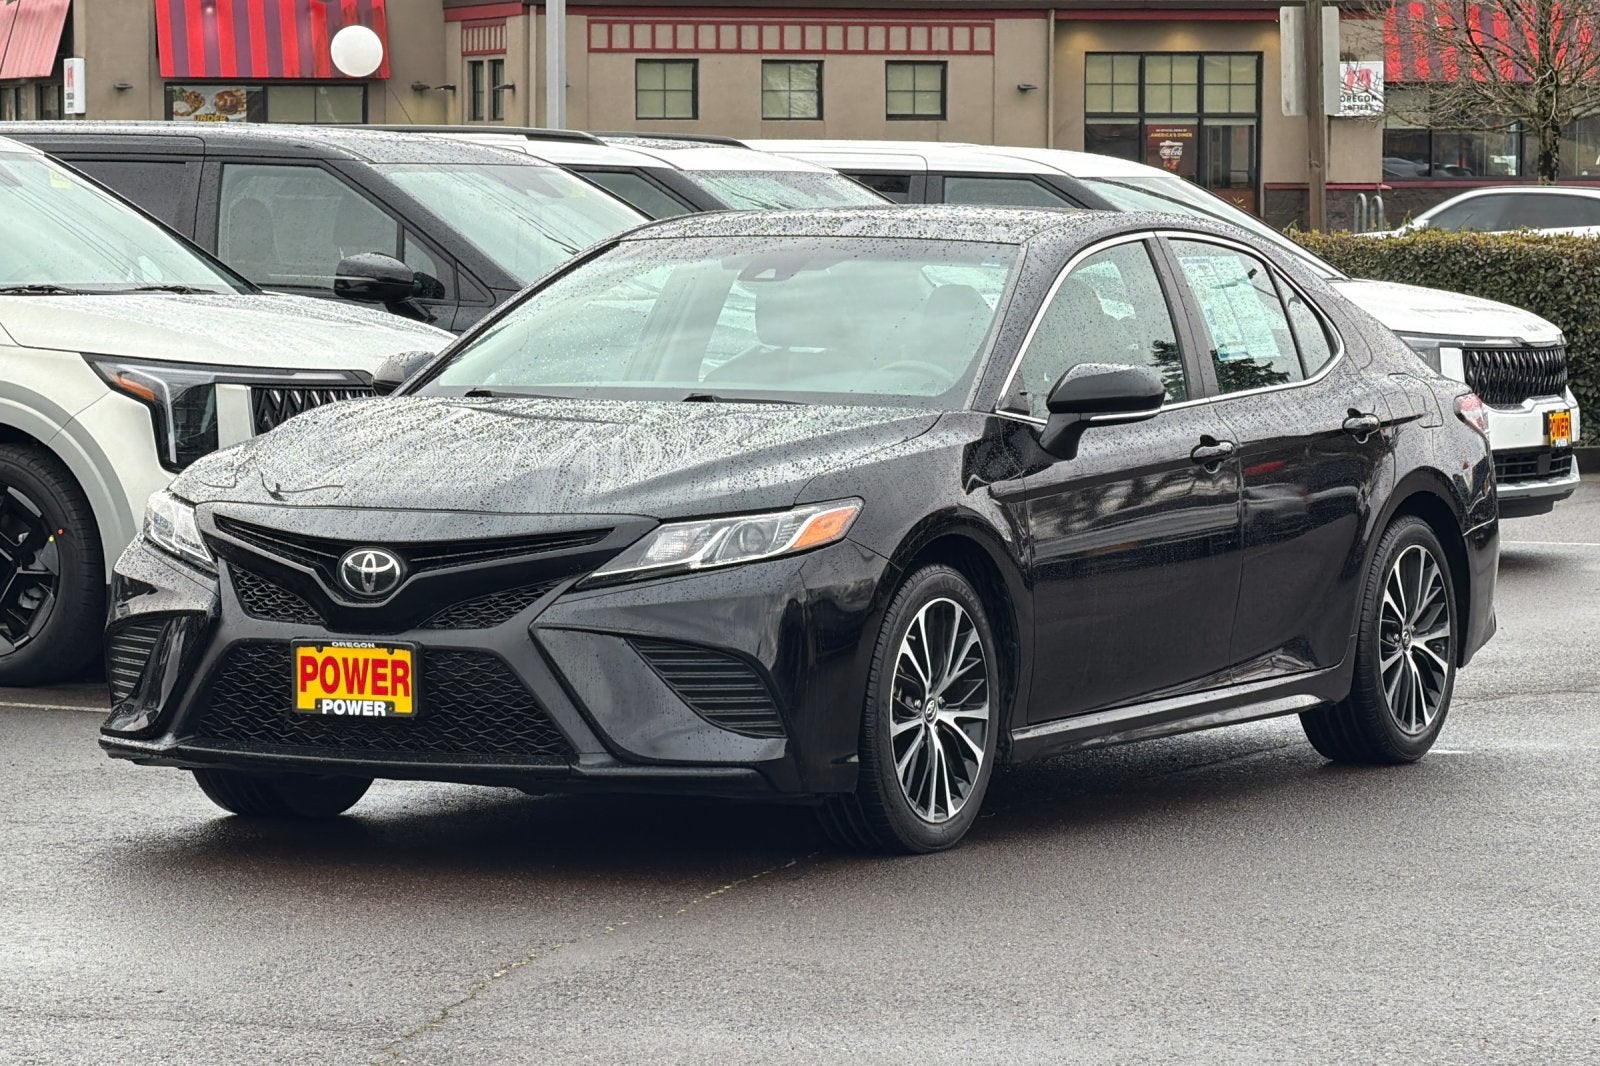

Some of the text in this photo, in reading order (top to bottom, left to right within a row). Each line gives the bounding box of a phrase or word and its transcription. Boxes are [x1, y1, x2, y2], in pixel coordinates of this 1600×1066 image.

[1548, 418, 1569, 437] POWER
[331, 641, 375, 649] OREGON
[300, 655, 410, 697] POWER
[321, 699, 386, 717] POWER
